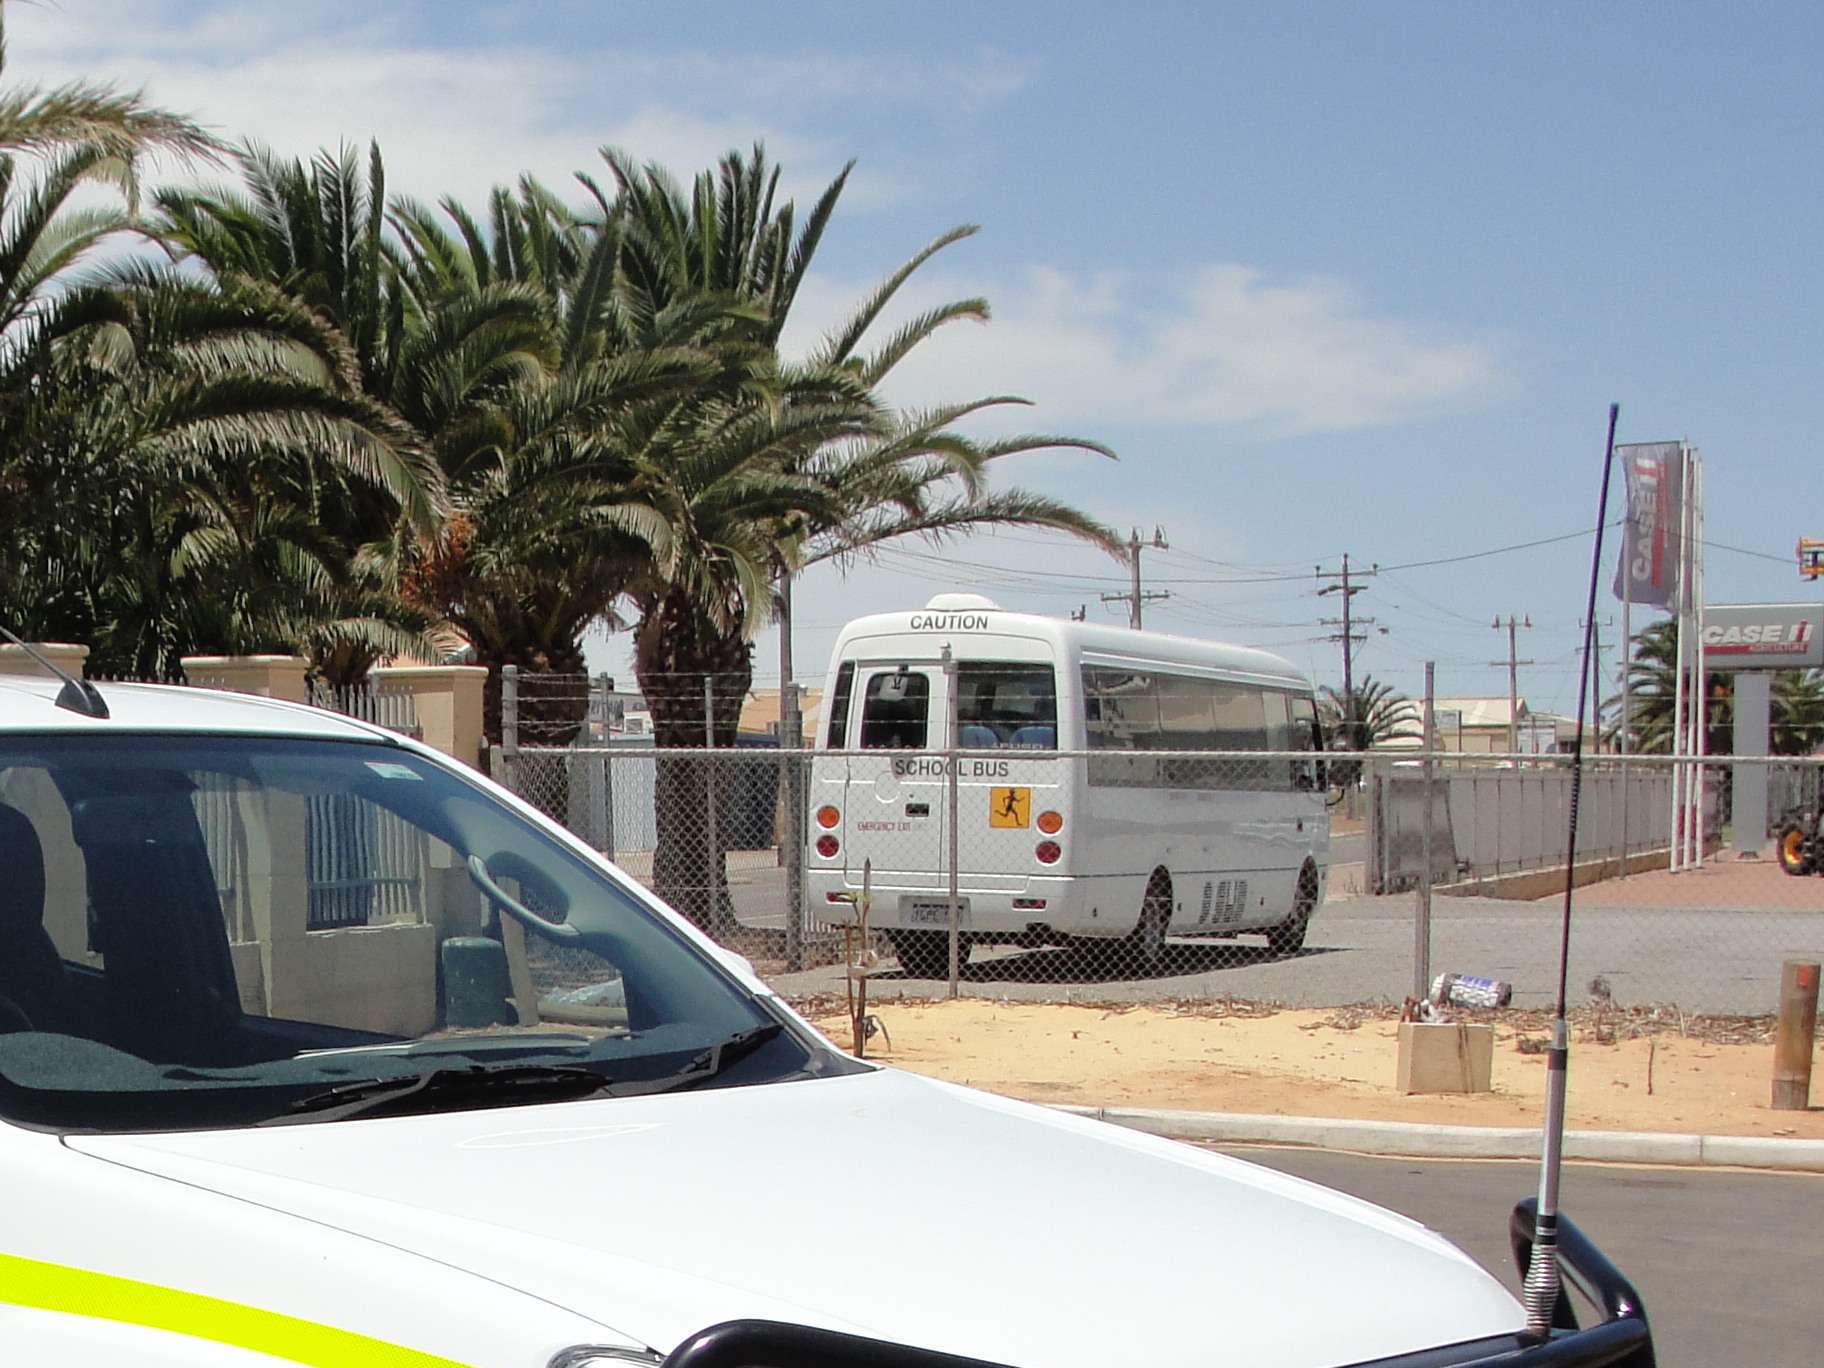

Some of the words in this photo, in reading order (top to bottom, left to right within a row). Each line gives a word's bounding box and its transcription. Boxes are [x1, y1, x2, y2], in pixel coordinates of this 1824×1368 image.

[910, 614, 989, 631] CAUTION
[1703, 625, 1783, 645] CASE
[973, 761, 1009, 778] BUS
